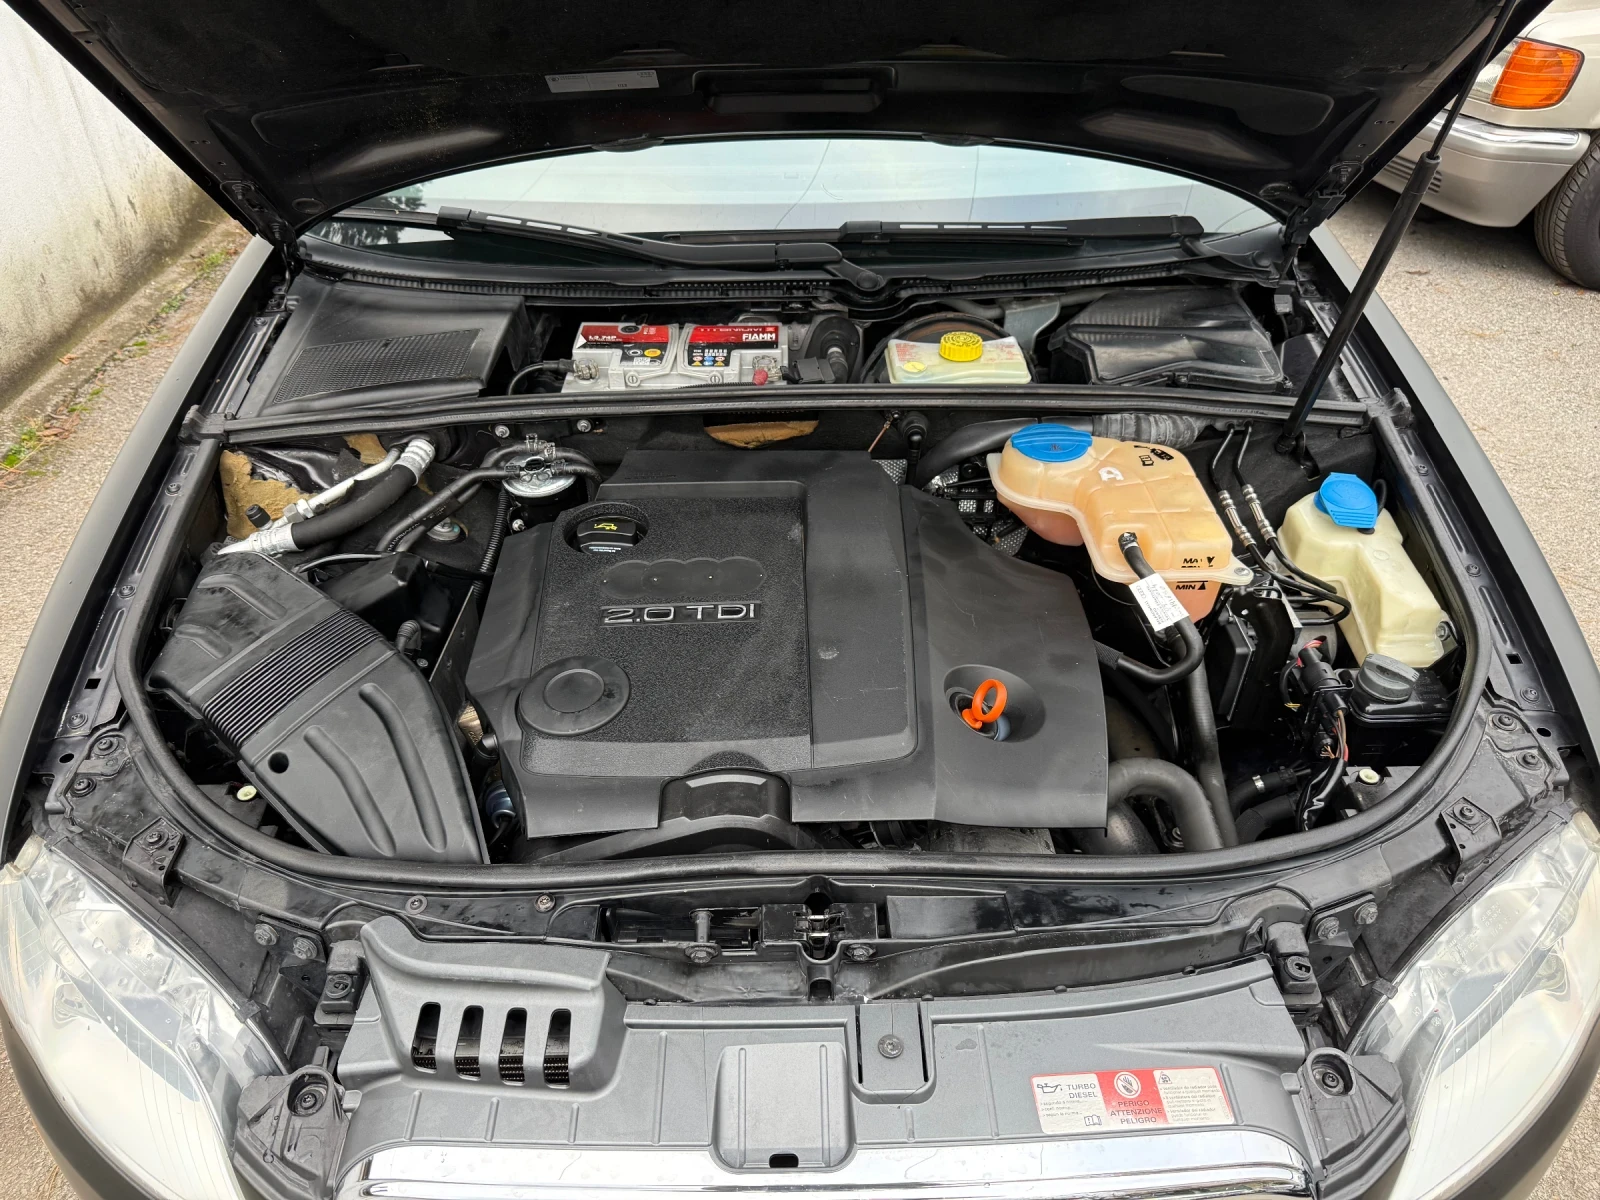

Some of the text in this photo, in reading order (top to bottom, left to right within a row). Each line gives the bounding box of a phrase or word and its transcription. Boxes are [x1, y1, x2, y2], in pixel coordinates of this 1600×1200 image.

[742, 333, 776, 342] FIAMM
[603, 603, 755, 623] 2.0 TDI
[1066, 1083, 1096, 1091] TURBO
[1069, 1091, 1098, 1099] DIESEL
[1110, 1108, 1163, 1117] ATTENZIONE
